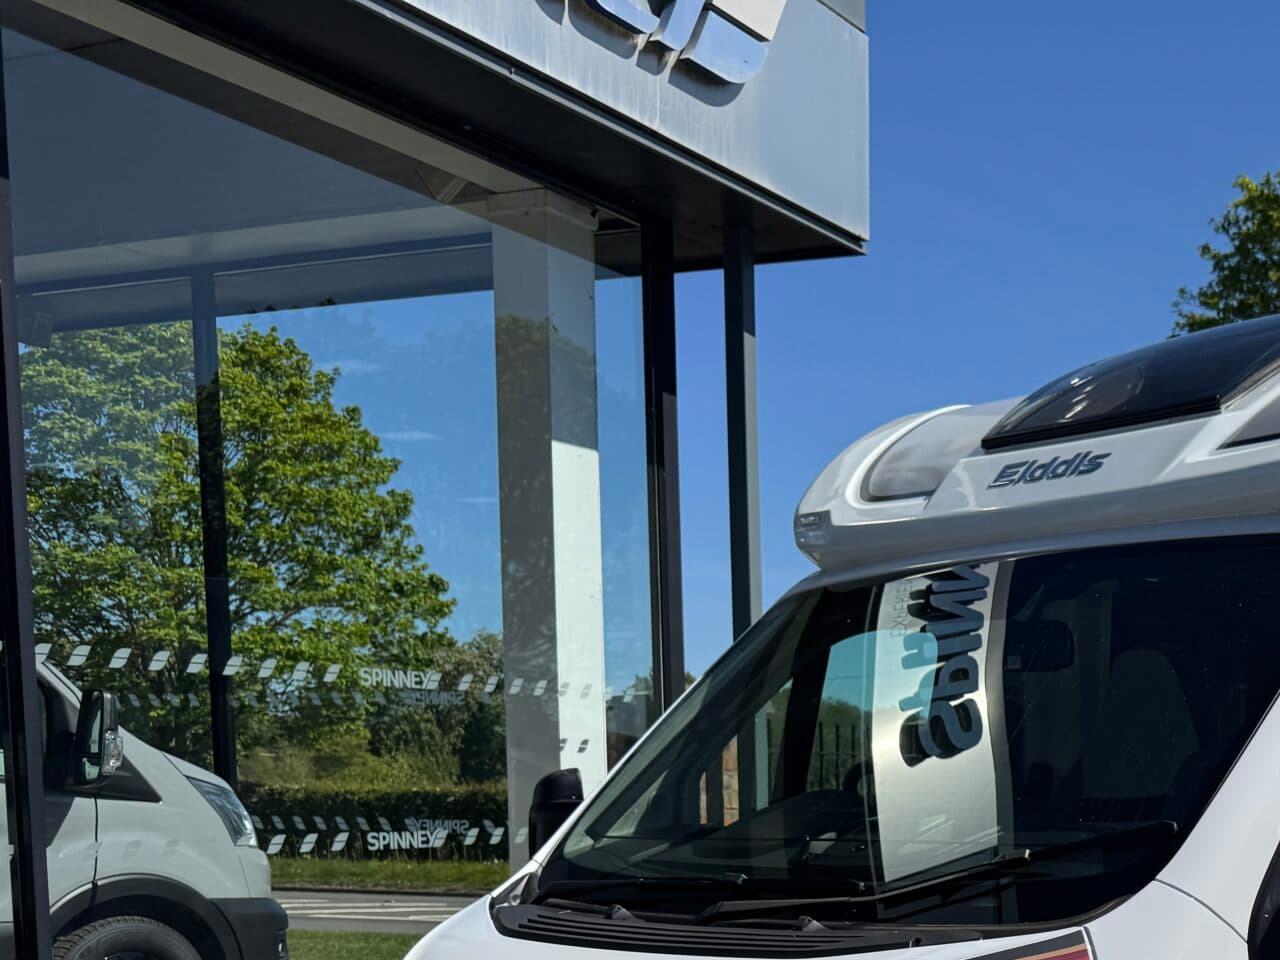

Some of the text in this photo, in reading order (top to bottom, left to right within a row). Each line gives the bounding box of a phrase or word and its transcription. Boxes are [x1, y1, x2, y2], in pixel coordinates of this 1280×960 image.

[987, 451, 1112, 489] Elddis
[360, 667, 433, 690] SPINNEY
[366, 829, 438, 851] SPINNEY
